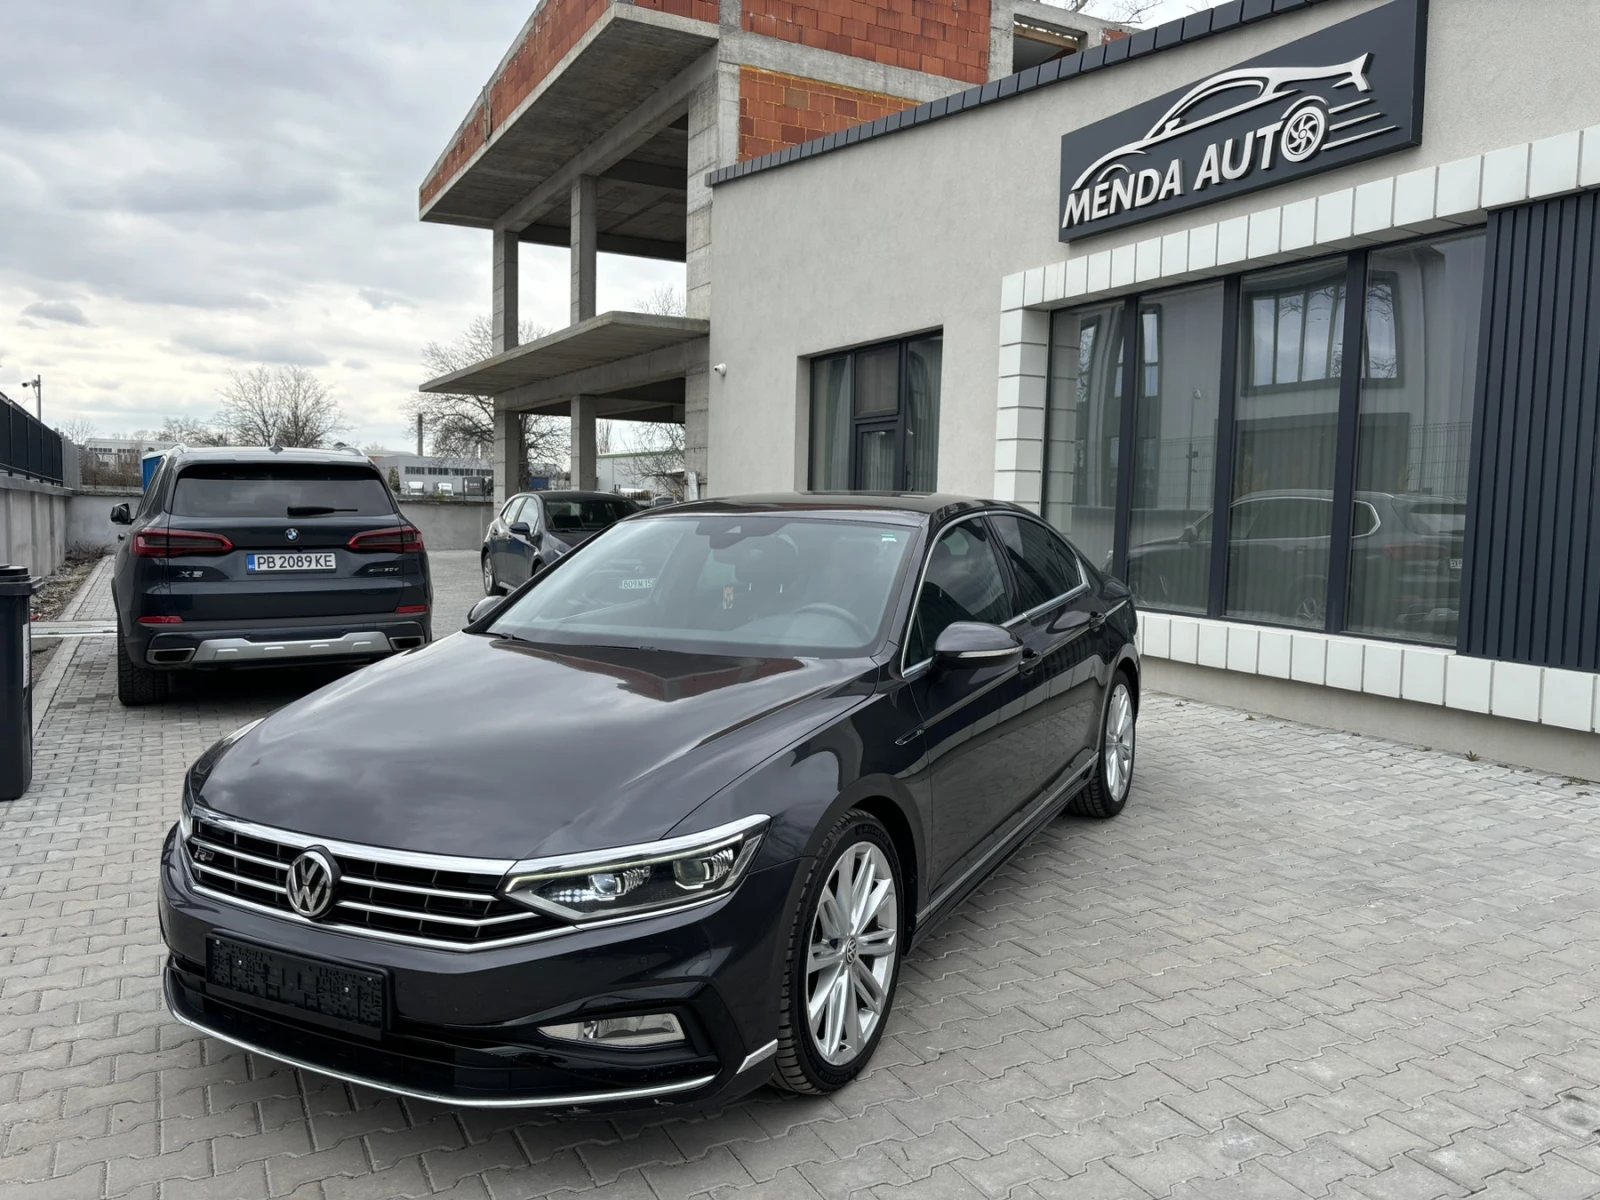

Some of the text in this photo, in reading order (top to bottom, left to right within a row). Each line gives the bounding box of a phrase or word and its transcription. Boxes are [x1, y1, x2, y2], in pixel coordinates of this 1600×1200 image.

[1062, 106, 1327, 229] MENDA AUTO
[257, 554, 333, 569] PB 2089 KE
